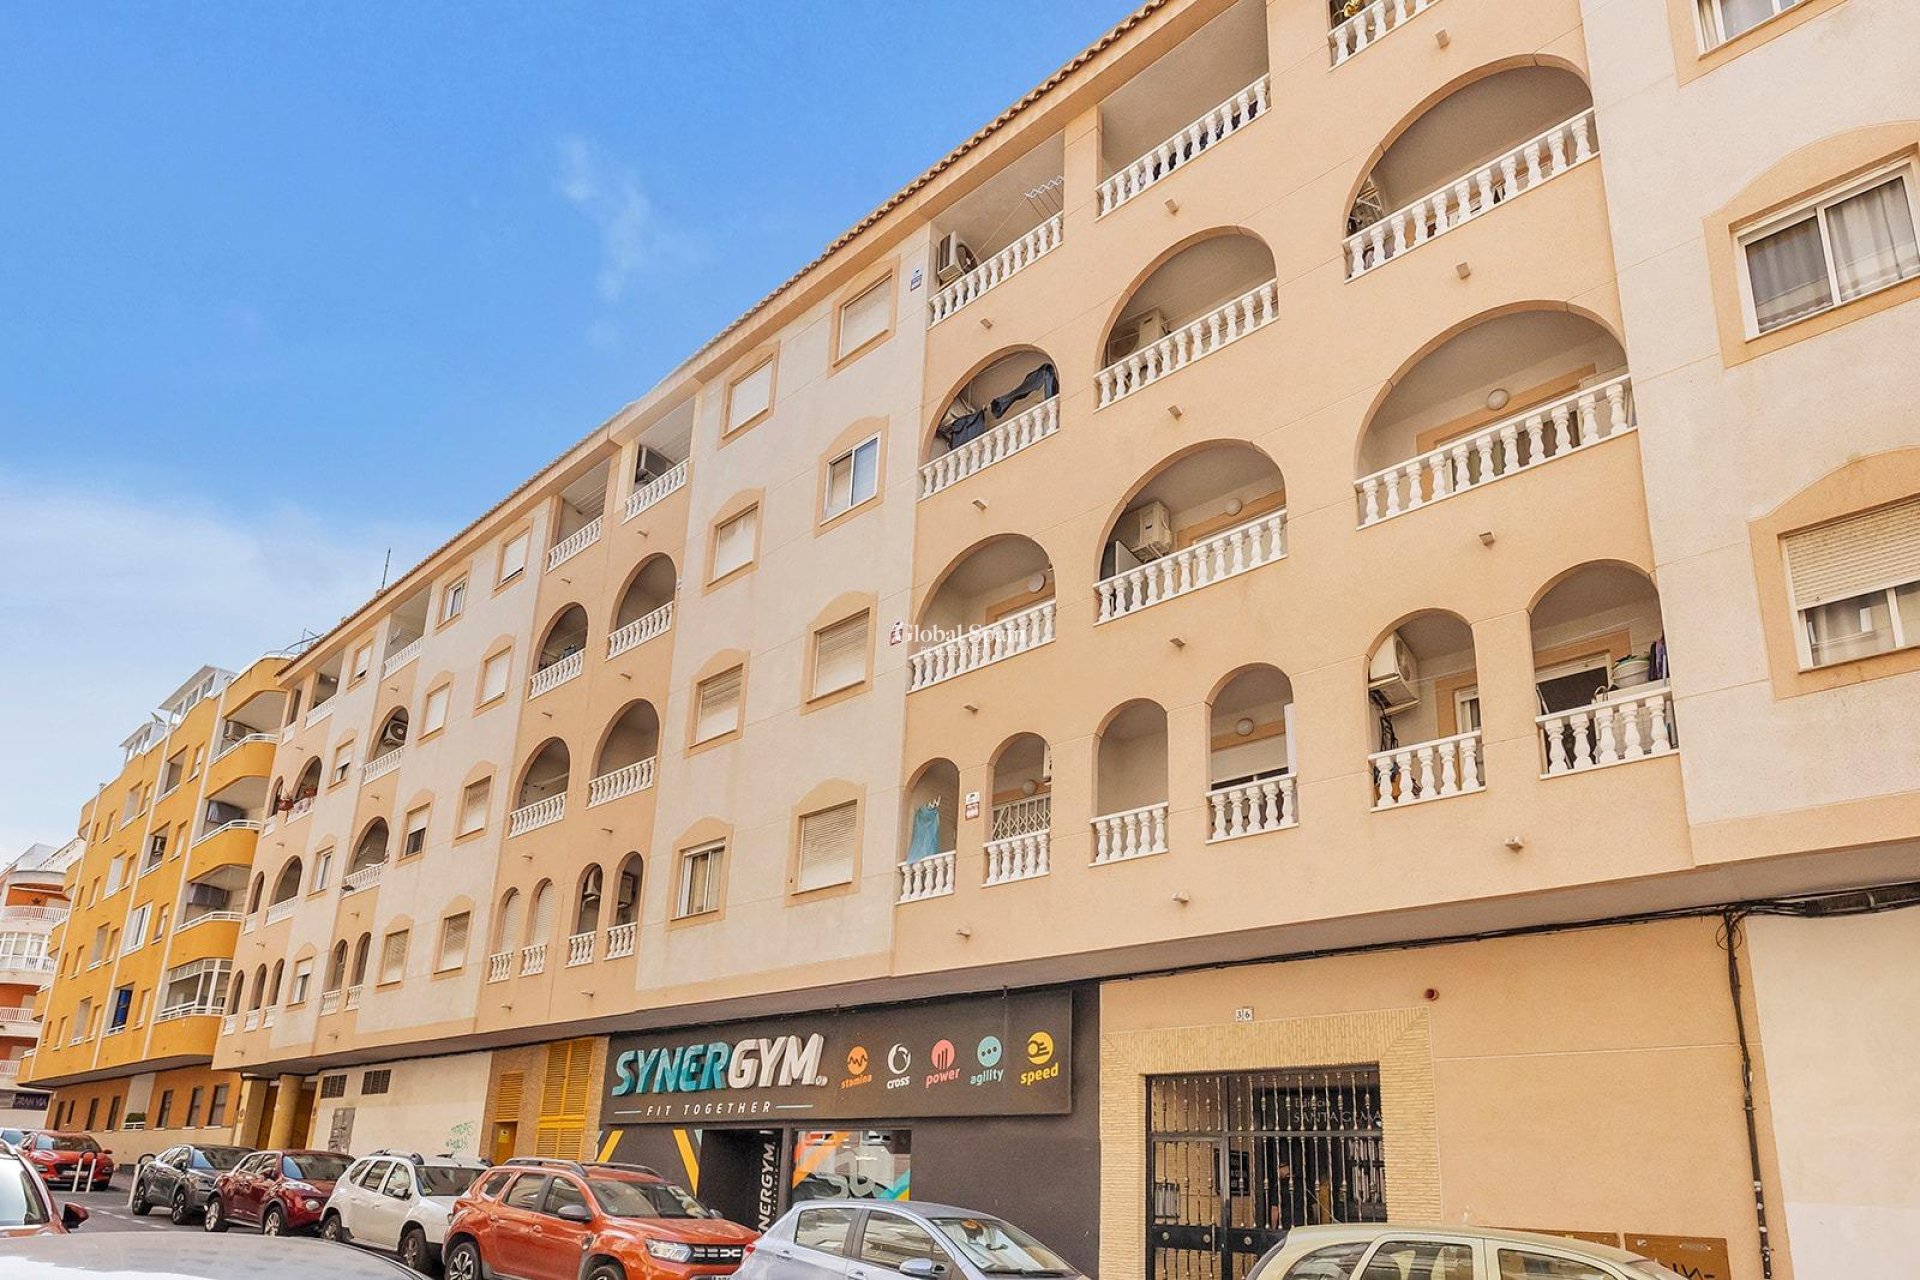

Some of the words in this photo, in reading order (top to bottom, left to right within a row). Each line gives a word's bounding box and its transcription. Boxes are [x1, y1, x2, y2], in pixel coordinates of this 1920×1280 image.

[611, 1033, 825, 1096] SYNERGYM
[840, 1073, 873, 1089] stamina
[886, 1076, 911, 1090] cross
[925, 1067, 961, 1088] power
[970, 1068, 1004, 1086] agility
[1020, 1062, 1059, 1086] speed
[646, 1105, 672, 1117] FIT
[683, 1101, 771, 1115] TOGETHER
[1341, 1110, 1382, 1123] GMA
[757, 1142, 775, 1235] NERGYM
